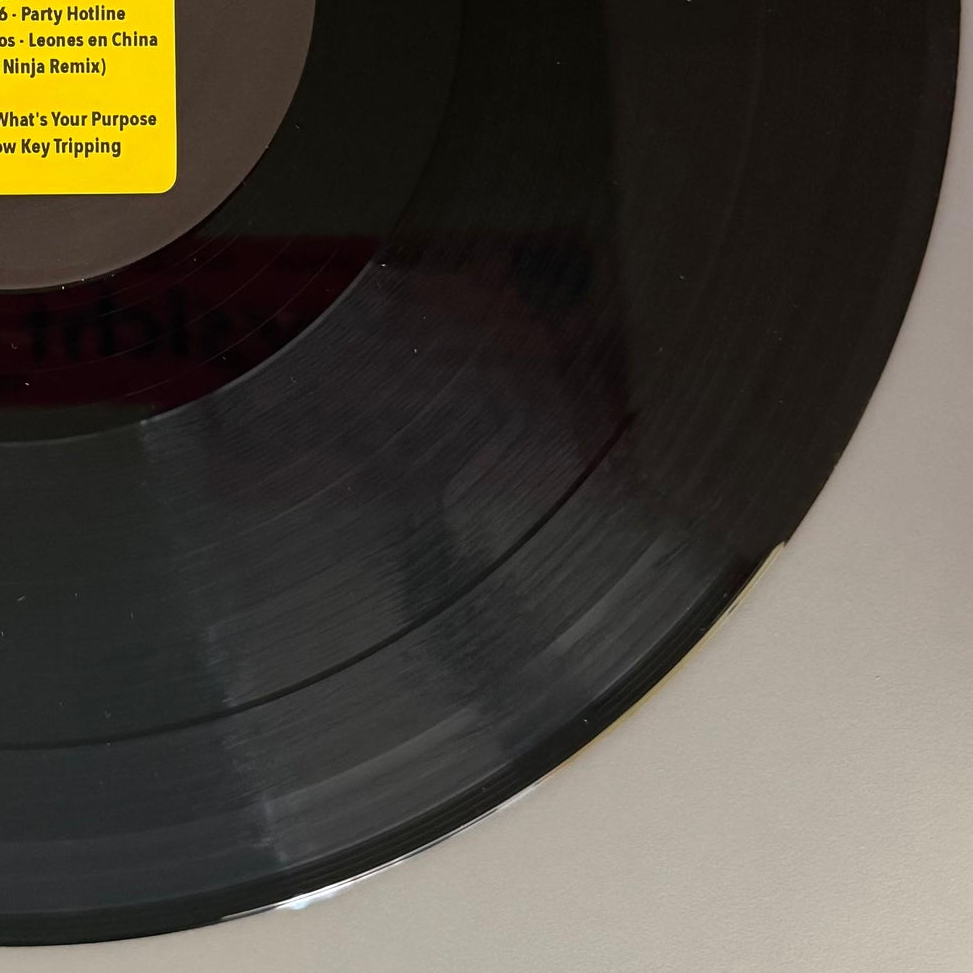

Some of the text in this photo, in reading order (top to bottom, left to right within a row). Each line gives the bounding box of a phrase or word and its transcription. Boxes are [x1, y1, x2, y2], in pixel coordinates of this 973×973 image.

[21, 6, 63, 25] Party
[67, 4, 126, 21] Hotline
[29, 32, 84, 48] Leones
[87, 35, 108, 47] en
[111, 30, 158, 47] China
[3, 57, 45, 79] Ninja
[49, 57, 106, 78] Remix)
[51, 111, 88, 127] Your
[91, 111, 157, 132] Purpose
[21, 138, 51, 159] Key
[53, 137, 121, 159] Tripping
